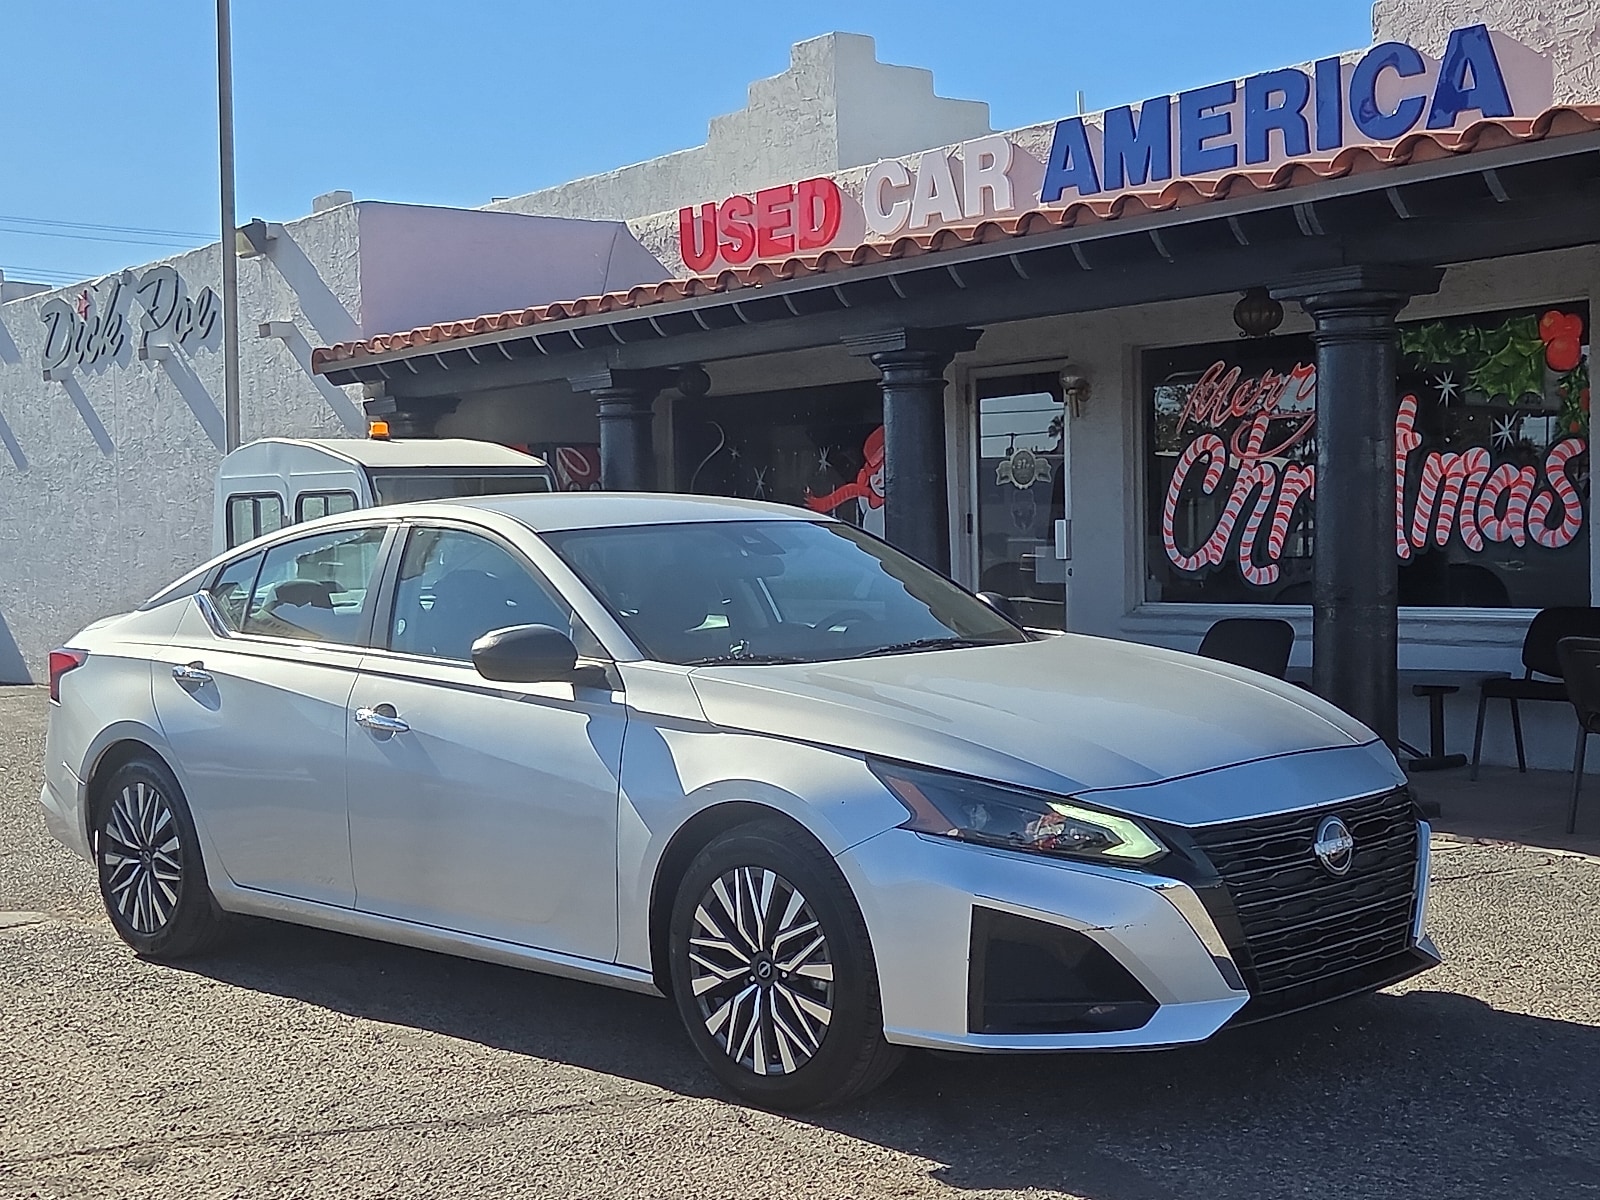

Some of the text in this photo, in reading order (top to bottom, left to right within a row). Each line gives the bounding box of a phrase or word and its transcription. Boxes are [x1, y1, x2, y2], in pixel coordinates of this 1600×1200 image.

[679, 24, 1514, 275] USED CAR AMERICA
[41, 266, 217, 369] Dick Poe
[1163, 394, 1586, 586] Chrtmas
